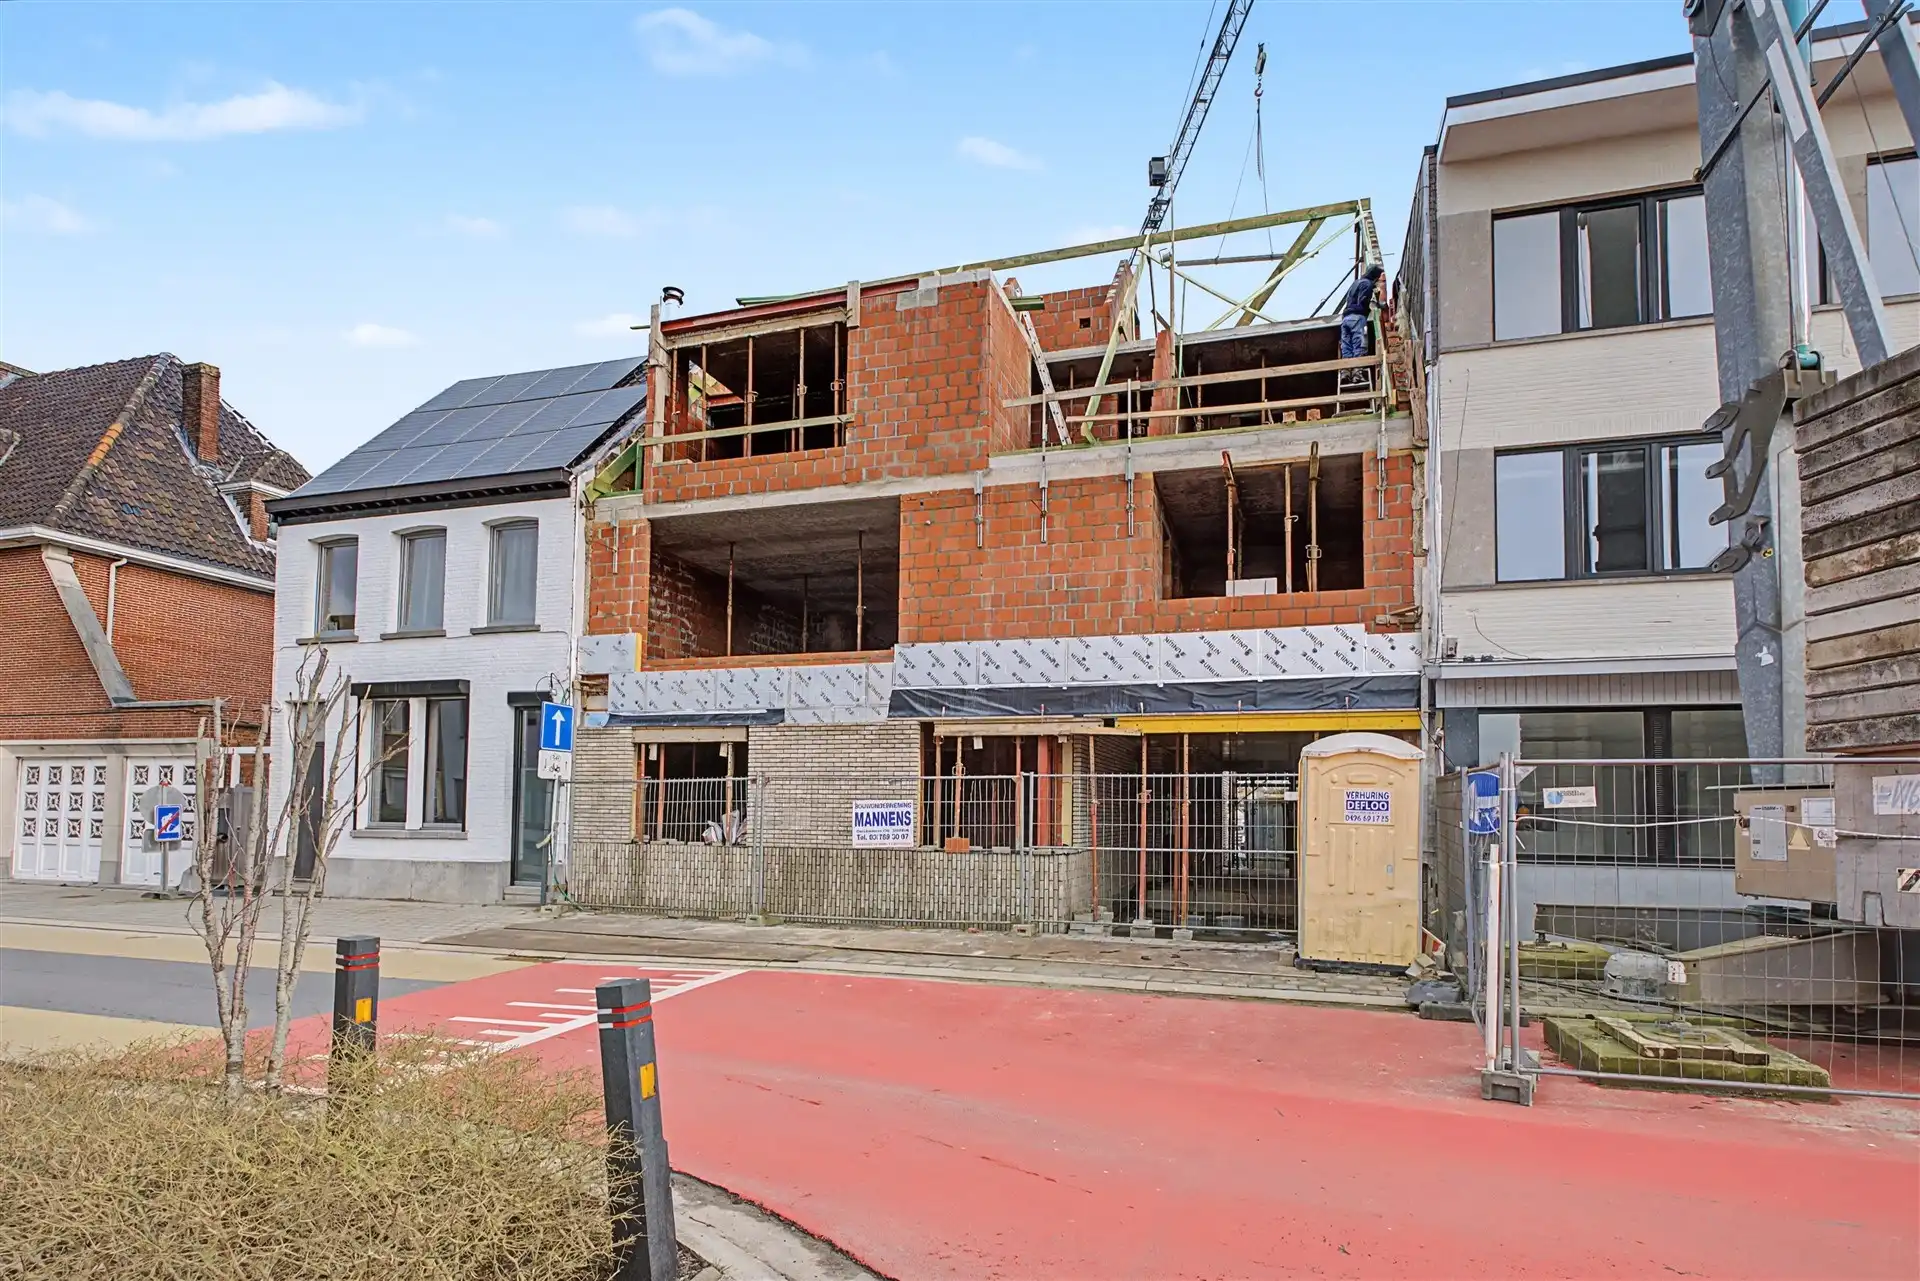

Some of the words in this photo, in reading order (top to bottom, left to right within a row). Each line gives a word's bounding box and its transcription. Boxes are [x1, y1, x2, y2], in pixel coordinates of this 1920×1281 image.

[1230, 633, 1249, 651] UNILIN
[1264, 629, 1283, 646] UNILIN
[1230, 657, 1248, 675] UNILIN
[1264, 653, 1283, 671] UNILIN
[1333, 650, 1353, 668] UNILIN
[1346, 791, 1389, 800] VERHURING
[1347, 801, 1388, 810] DEFLOO
[855, 811, 911, 827] MANNENS
